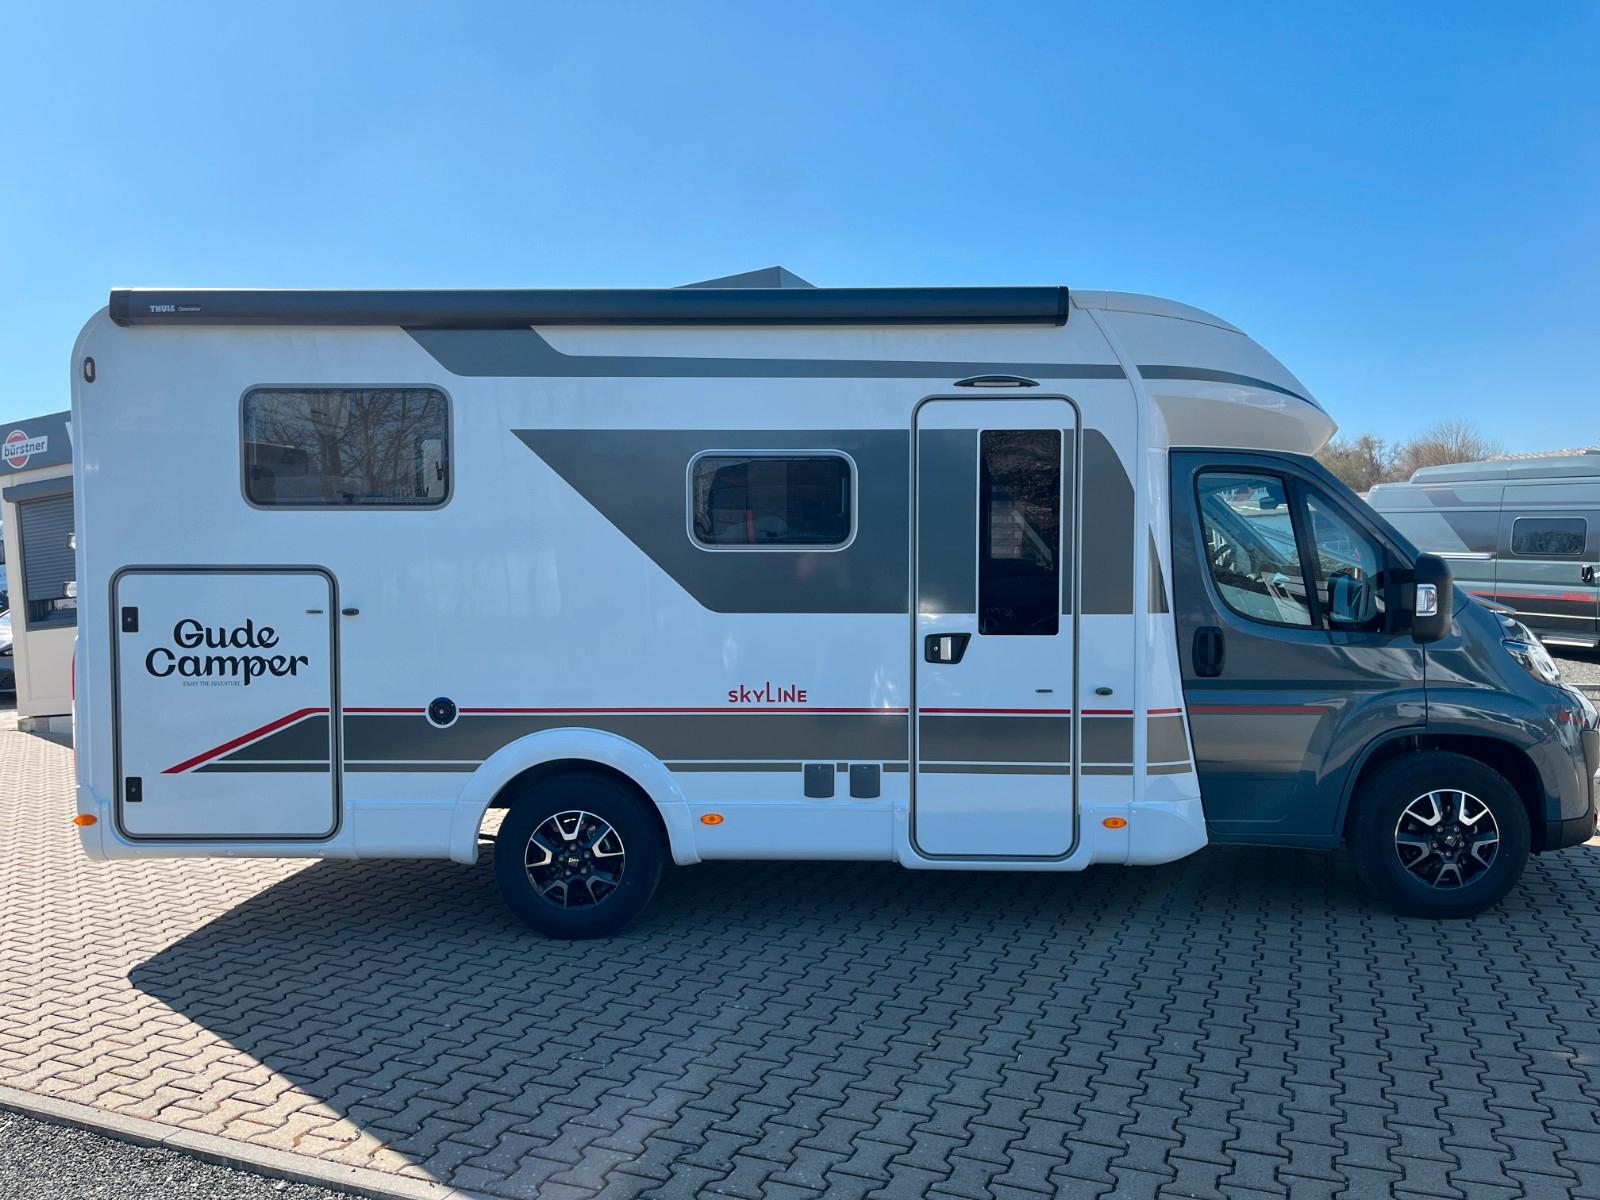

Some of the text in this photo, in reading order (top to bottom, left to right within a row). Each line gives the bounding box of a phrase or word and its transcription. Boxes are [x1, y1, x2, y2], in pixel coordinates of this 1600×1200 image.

[150, 304, 176, 313] THULE
[4, 441, 46, 457] bürstner
[173, 618, 280, 649] Gude
[145, 647, 309, 686] Camper
